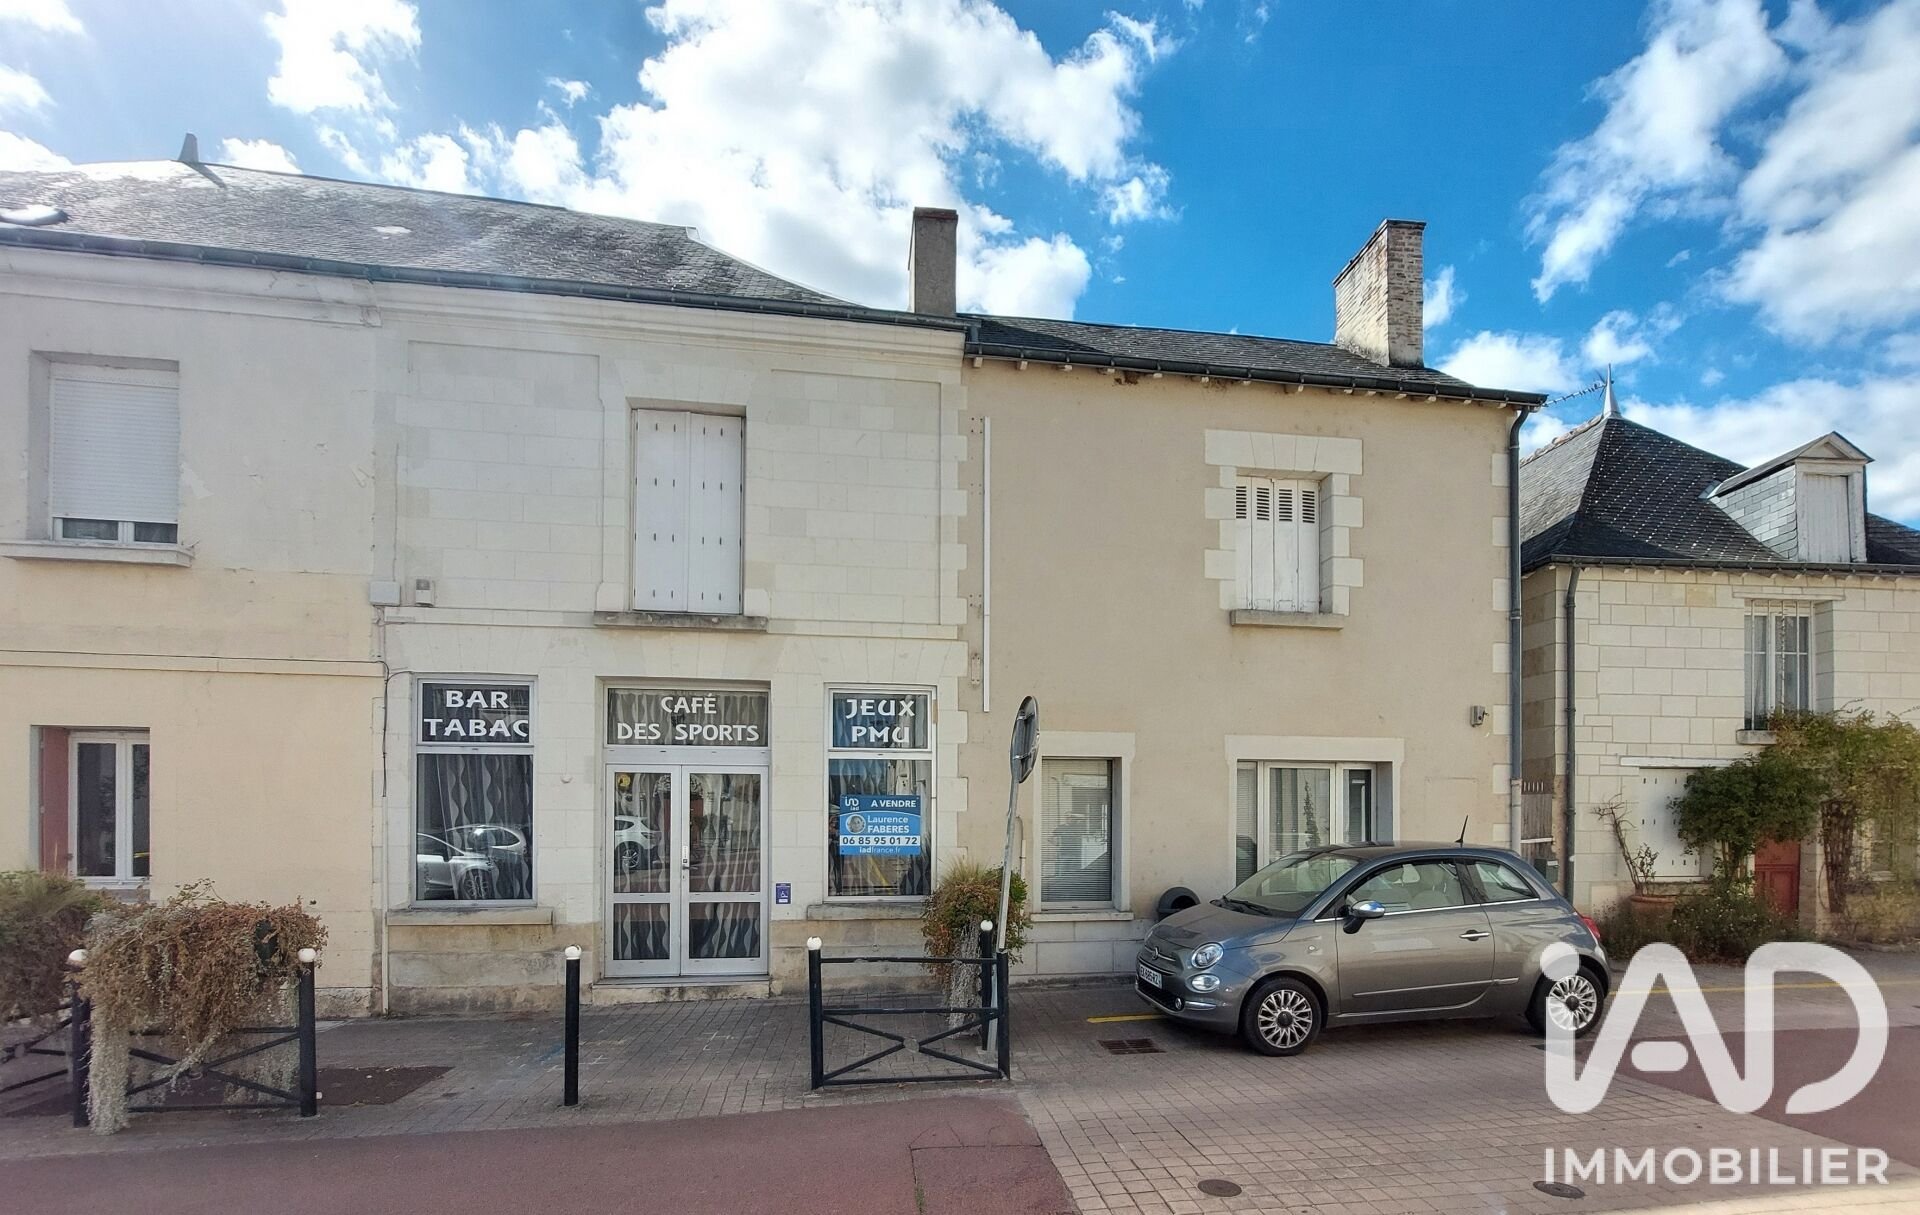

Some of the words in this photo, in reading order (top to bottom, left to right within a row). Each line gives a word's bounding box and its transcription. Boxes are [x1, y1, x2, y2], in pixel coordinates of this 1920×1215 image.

[446, 690, 508, 708] BAR
[661, 692, 717, 714] CAFÉ
[845, 699, 915, 719] JEUX
[423, 718, 529, 737] TABAC
[617, 723, 661, 740] DES
[674, 724, 760, 742] SPORTS
[851, 726, 910, 743] PMU
[880, 800, 917, 808] VENDRE
[867, 815, 909, 823] Laurence
[867, 825, 910, 834] FABERES
[842, 836, 855, 845] 06
[858, 836, 871, 845] 85
[874, 836, 886, 845] 95
[889, 836, 901, 845] 01
[905, 836, 918, 845] 72
